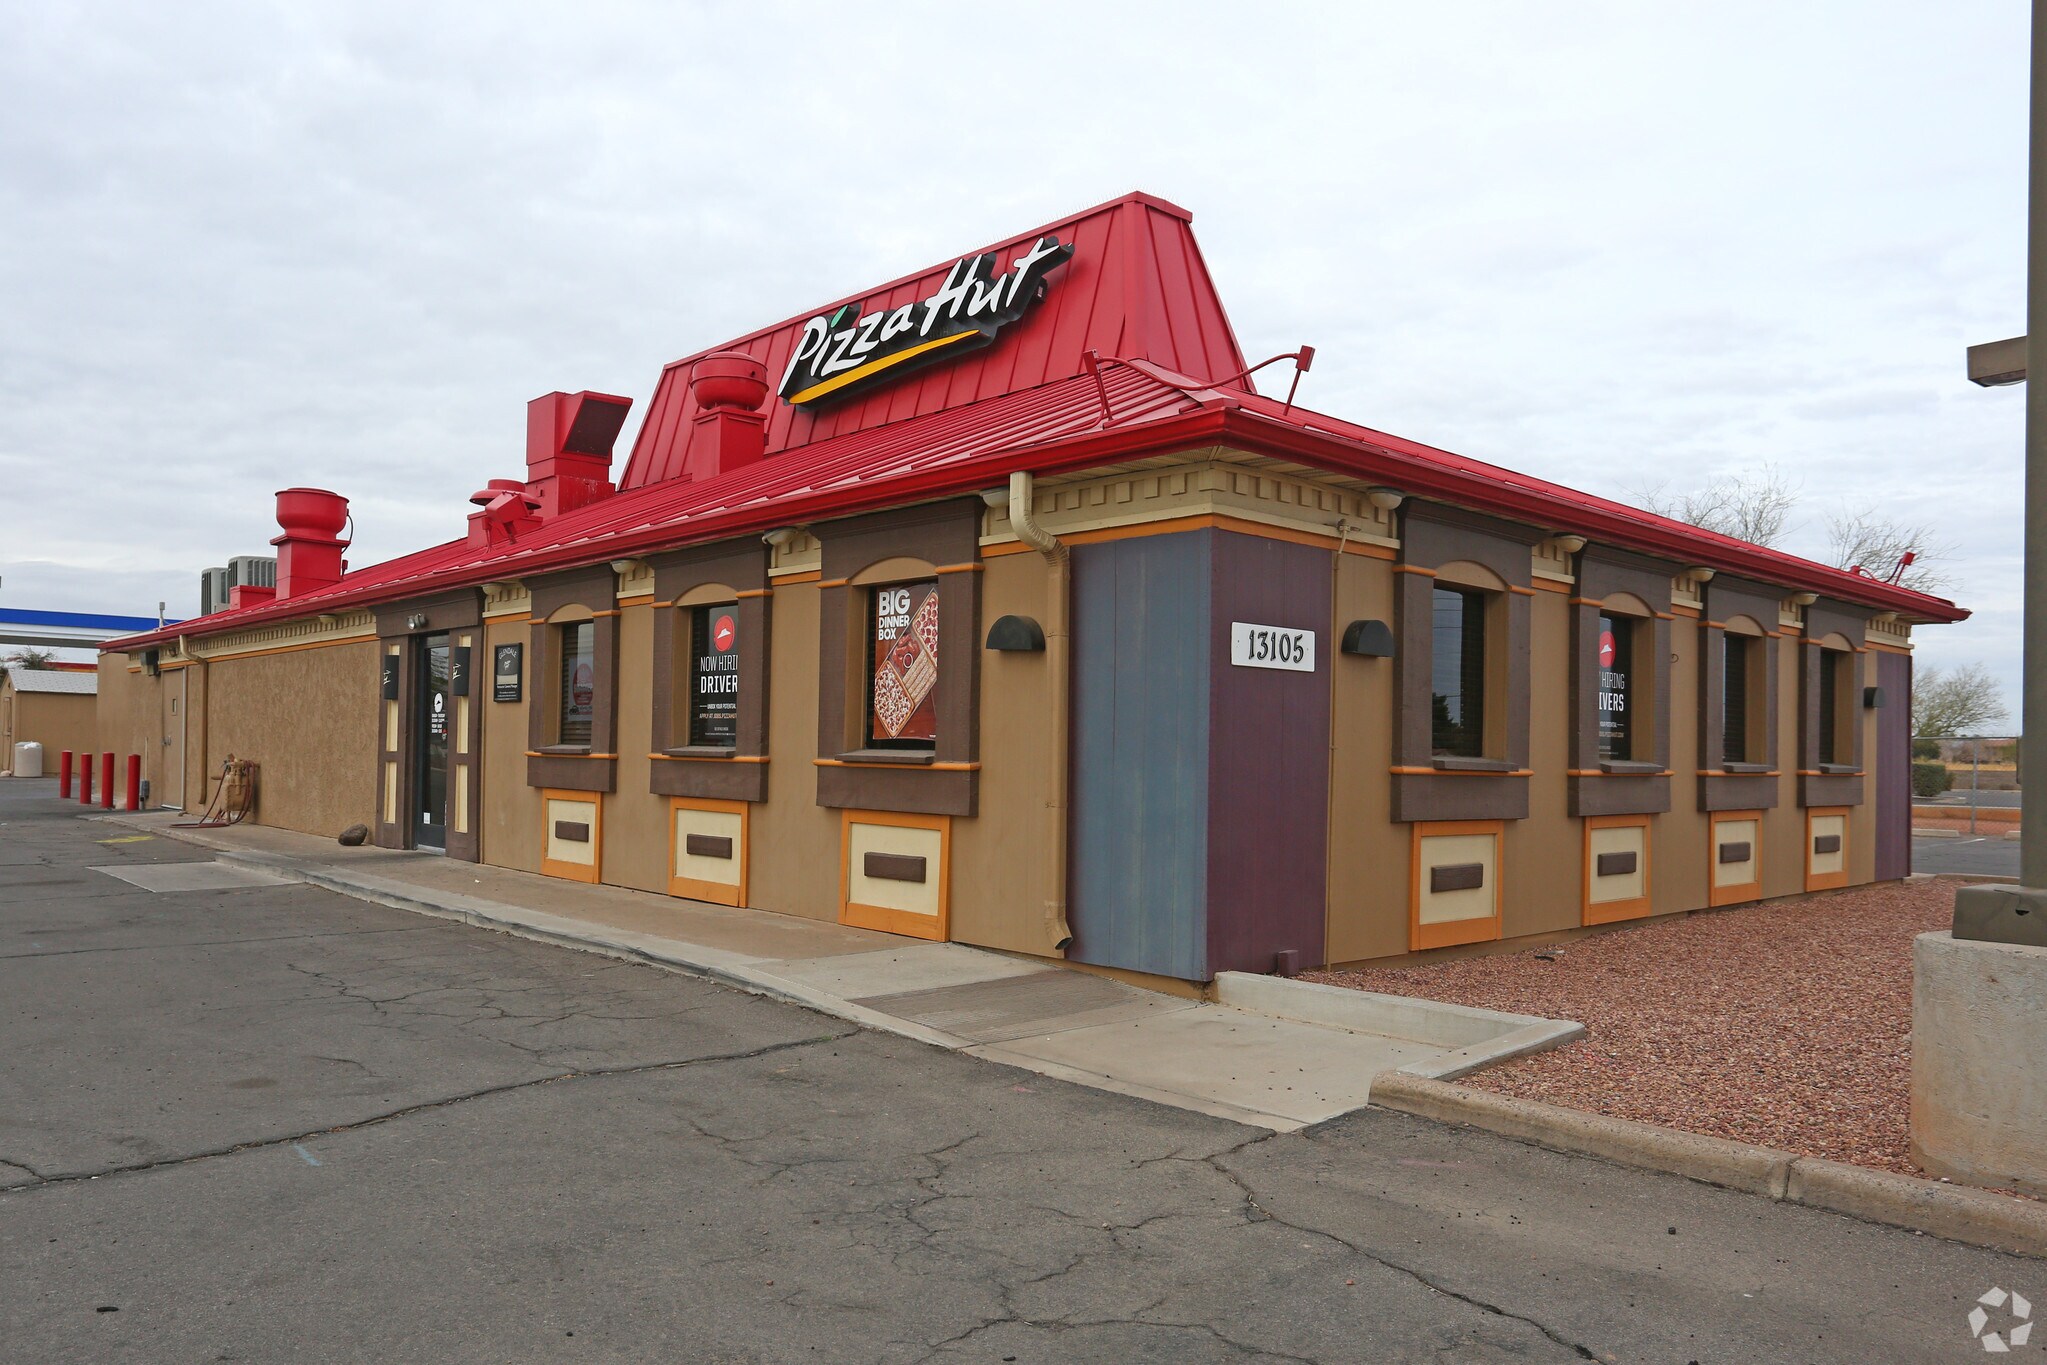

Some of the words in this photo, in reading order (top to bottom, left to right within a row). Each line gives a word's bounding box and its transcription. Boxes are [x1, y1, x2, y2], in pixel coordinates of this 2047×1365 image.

[777, 304, 915, 397] Pizza
[920, 236, 1061, 338] Hut
[879, 590, 911, 616] BIG
[878, 615, 910, 630] DINNER
[878, 627, 897, 641] BOX
[1248, 629, 1304, 663] 13105
[700, 656, 717, 672] NOW
[1601, 672, 1625, 689] HIRING
